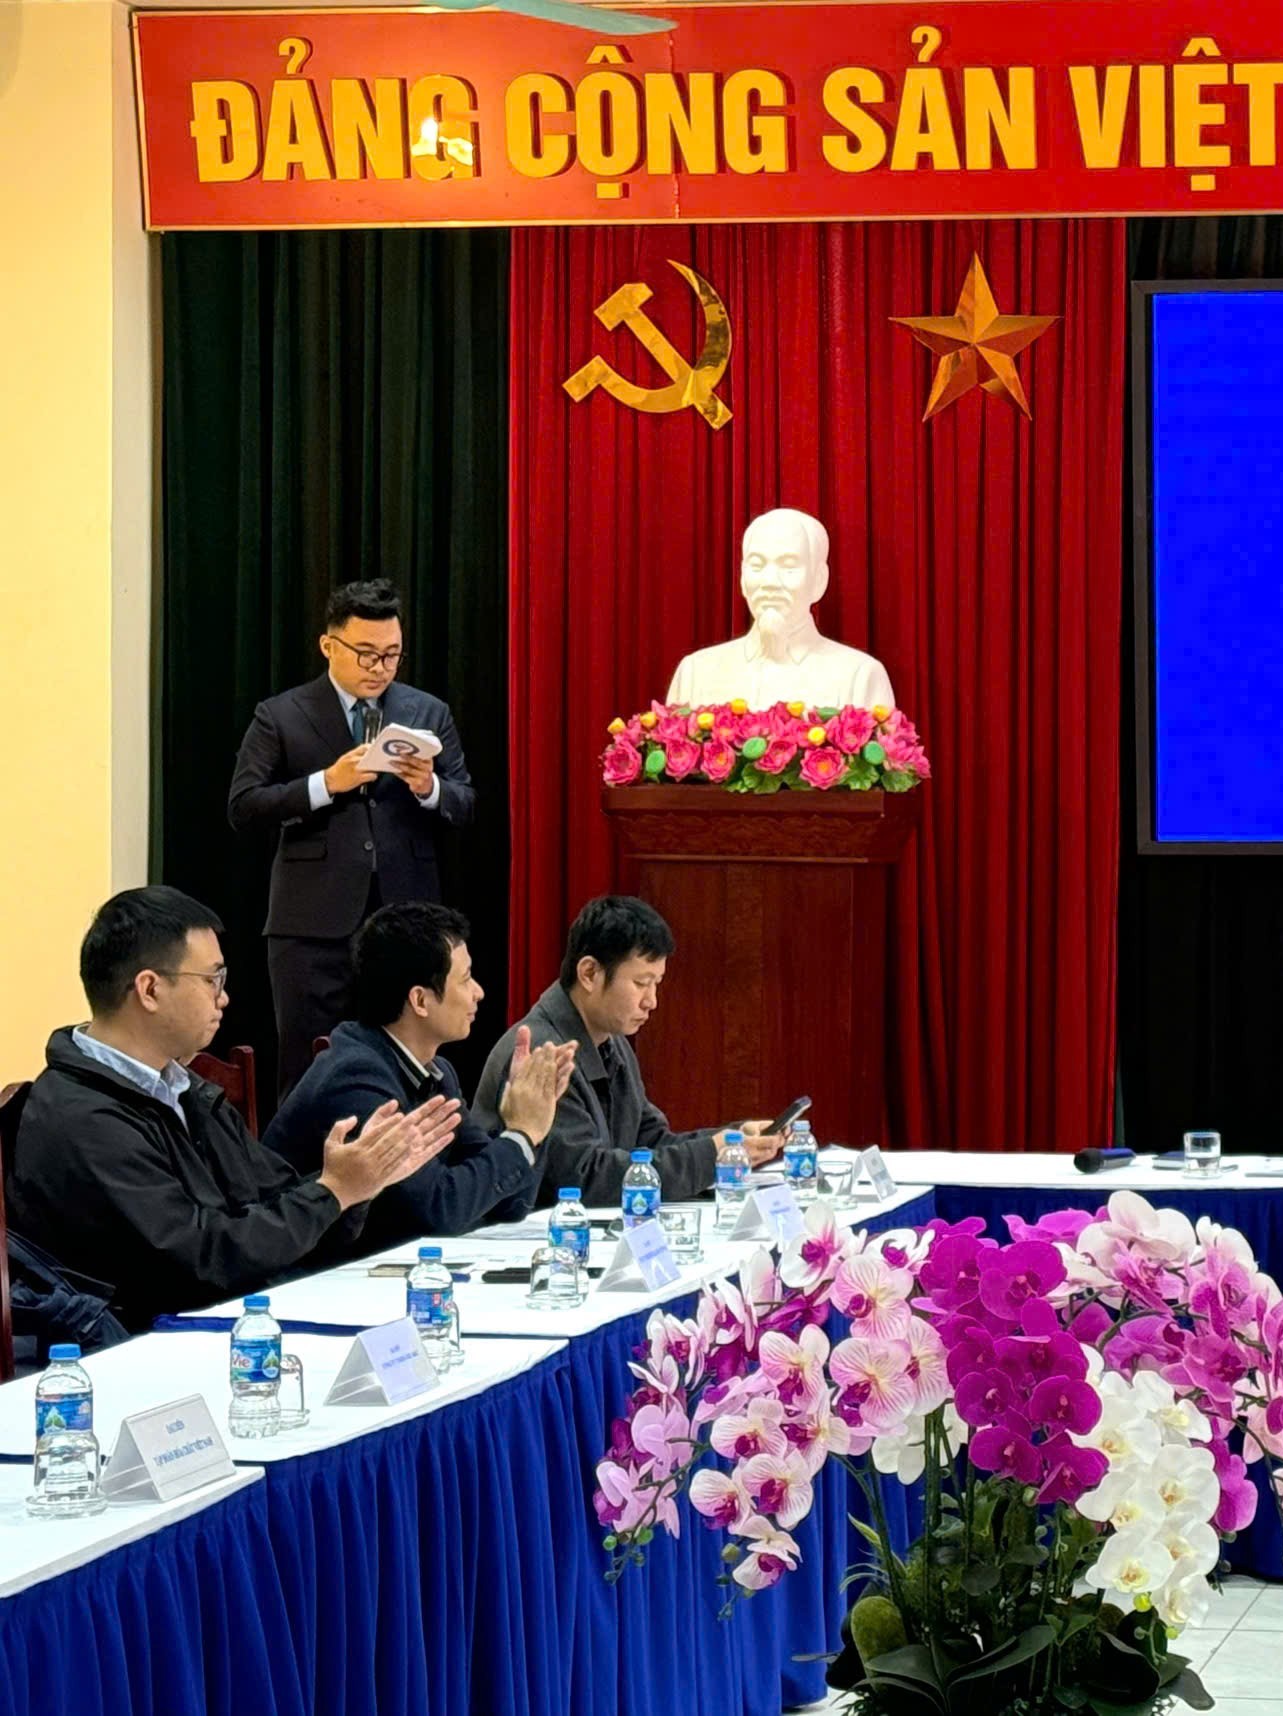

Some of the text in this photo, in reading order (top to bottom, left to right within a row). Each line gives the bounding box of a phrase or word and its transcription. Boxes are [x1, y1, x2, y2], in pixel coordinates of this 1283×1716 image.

[190, 37, 478, 183] ĐẢNG
[505, 46, 788, 199] CỘNG
[822, 26, 1036, 172] SẢN
